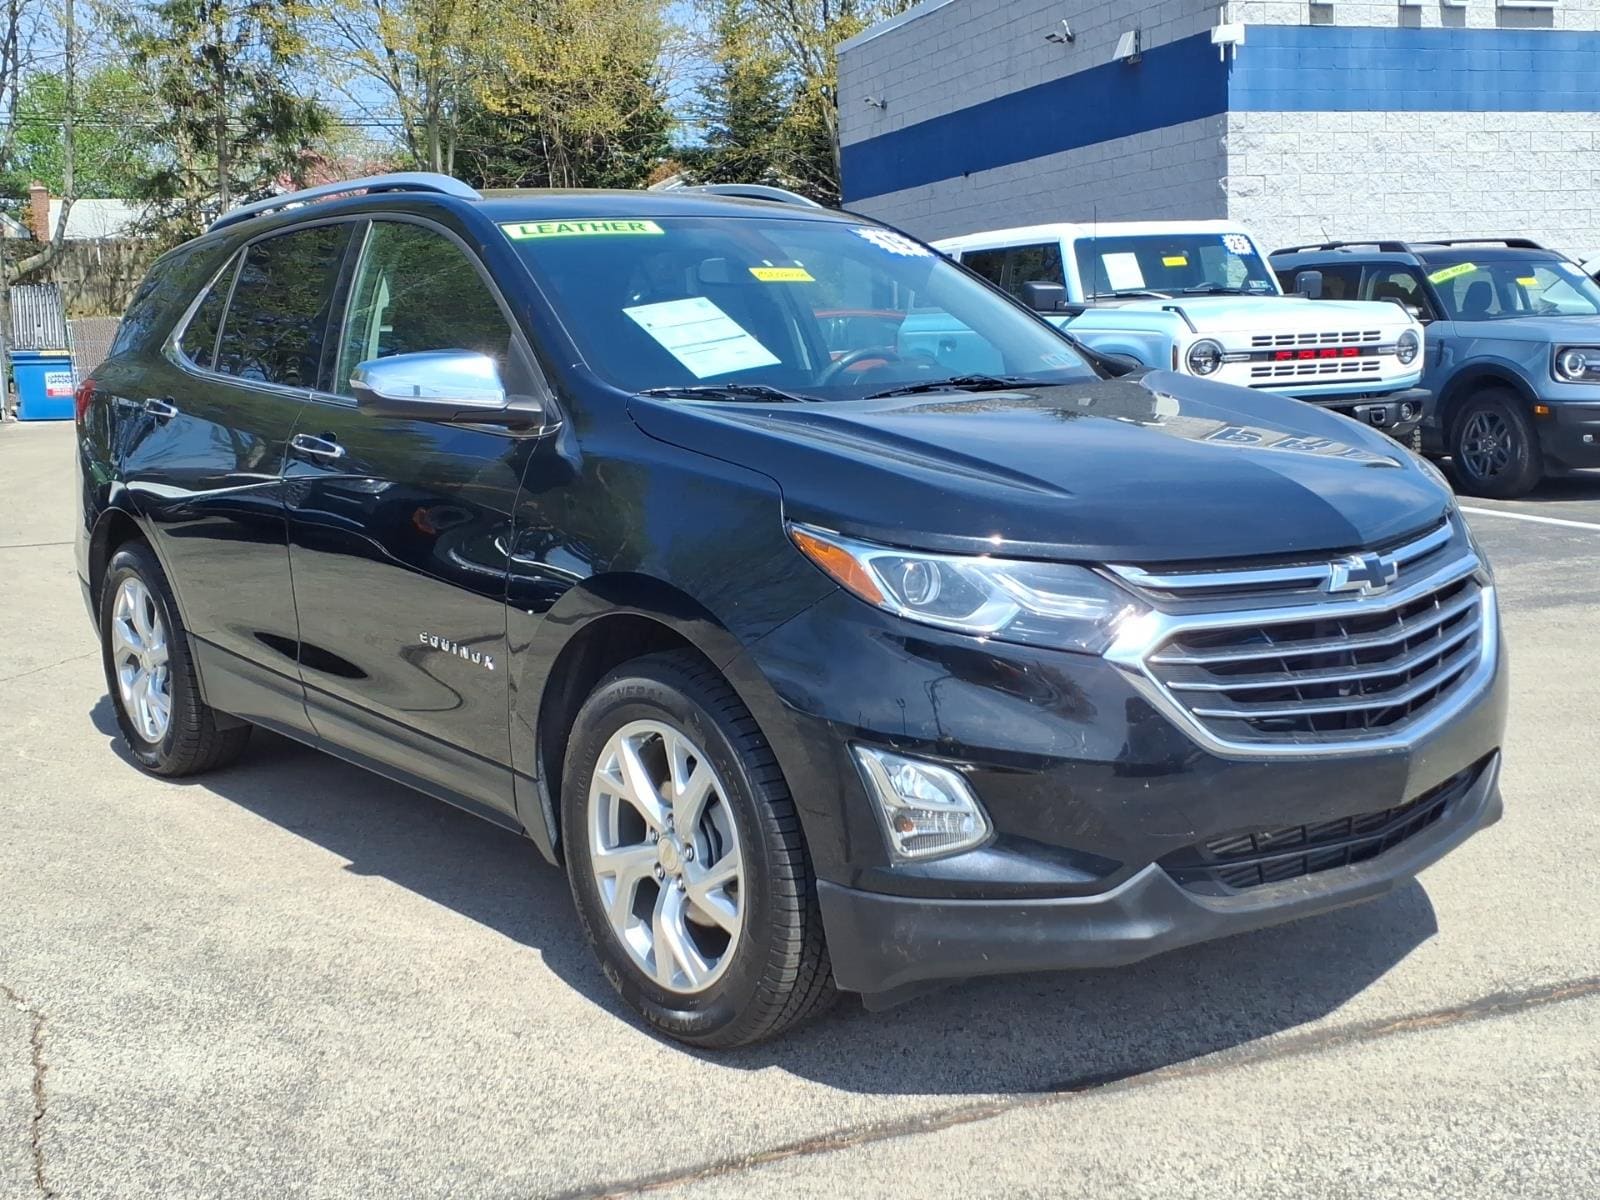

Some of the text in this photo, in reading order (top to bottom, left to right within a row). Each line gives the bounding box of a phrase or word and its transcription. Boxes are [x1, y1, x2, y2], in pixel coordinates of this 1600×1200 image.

[519, 222, 647, 235] LEATHER
[1275, 346, 1360, 361] FORD
[419, 631, 494, 671] EQUINOX
